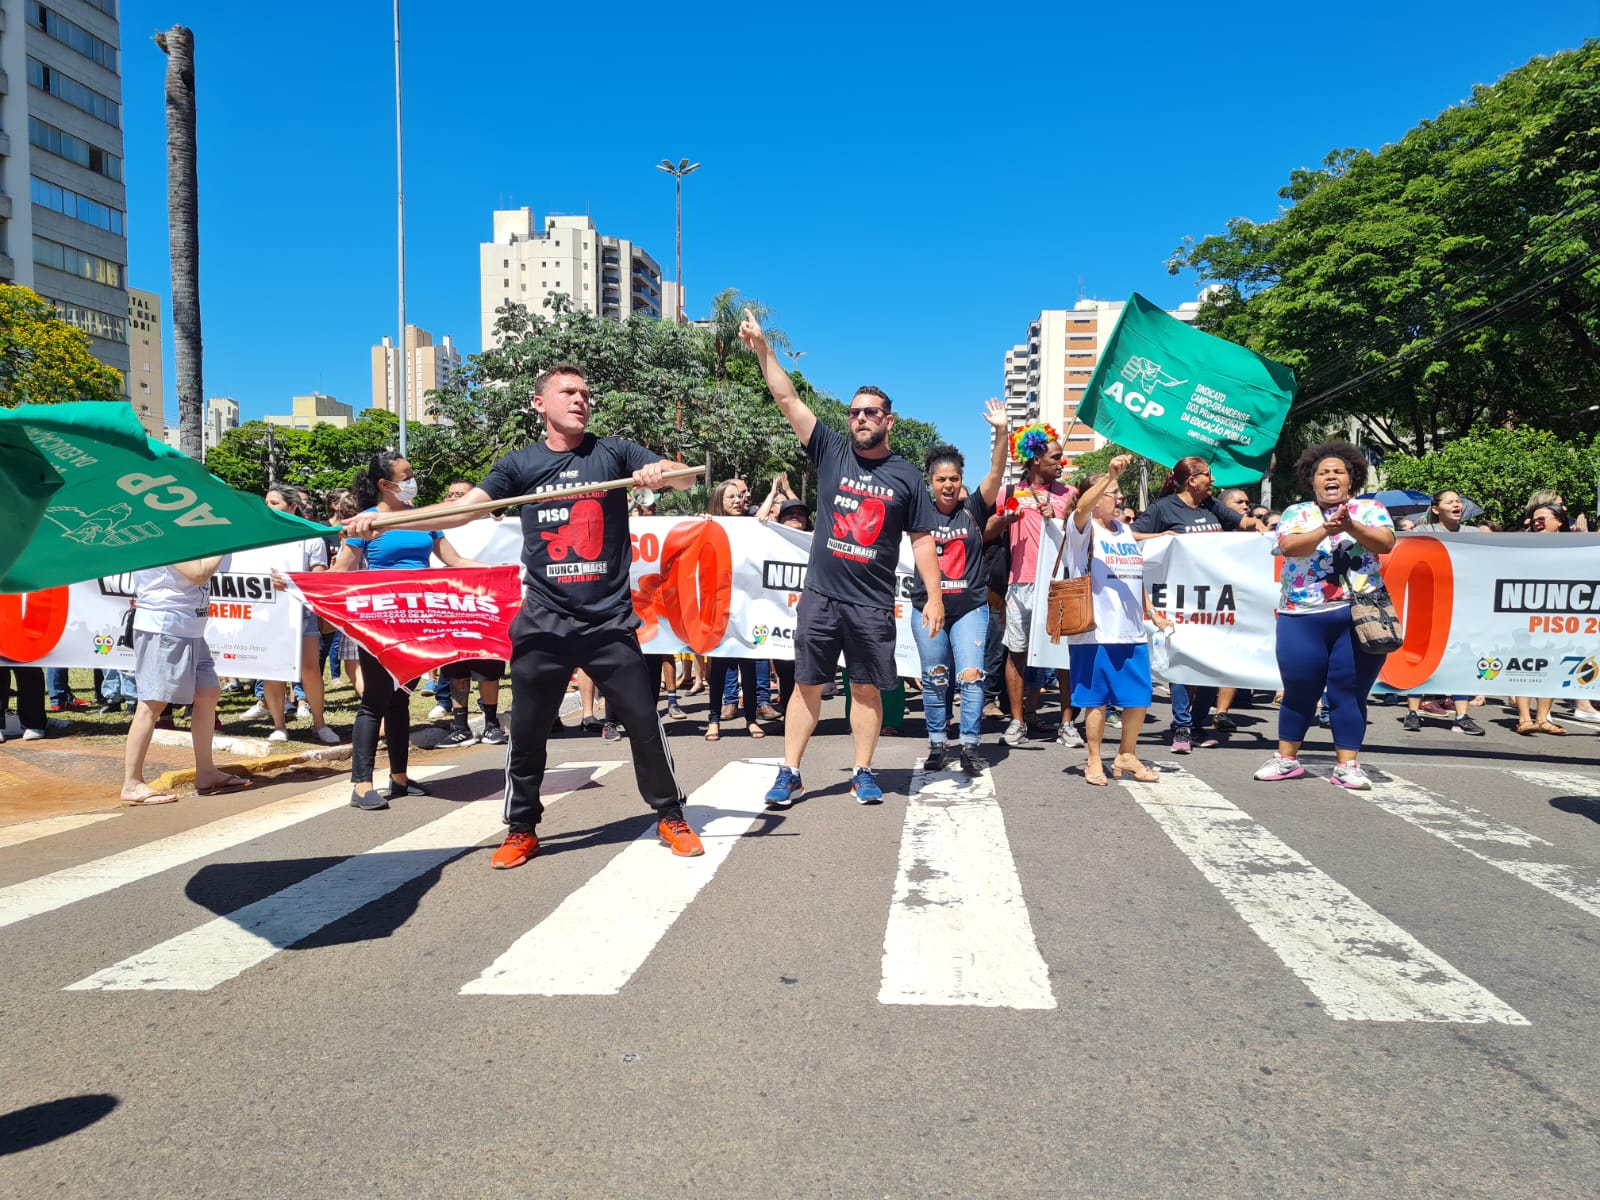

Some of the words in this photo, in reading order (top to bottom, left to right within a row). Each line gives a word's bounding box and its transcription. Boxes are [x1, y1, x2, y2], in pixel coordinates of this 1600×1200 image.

[1104, 381, 1165, 418] ACP
[1195, 384, 1226, 402] SINDICATO
[1186, 402, 1199, 413] DOS
[1181, 412, 1191, 422] DA
[1190, 416, 1224, 435] EDUCAÇÃO
[116, 472, 232, 527] ACP
[834, 495, 859, 510] PISO
[538, 508, 569, 523] PISO
[828, 539, 852, 553] NUNCA
[855, 546, 877, 559] MAIS!
[548, 565, 580, 575] NUNCA
[346, 592, 499, 613] FETEMS
[1152, 583, 1236, 611] EITA
[1175, 612, 1235, 625] 5.411/14
[1529, 616, 1579, 633] PISO
[1584, 617, 1600, 633] 2
[1506, 658, 1549, 671] ACP
